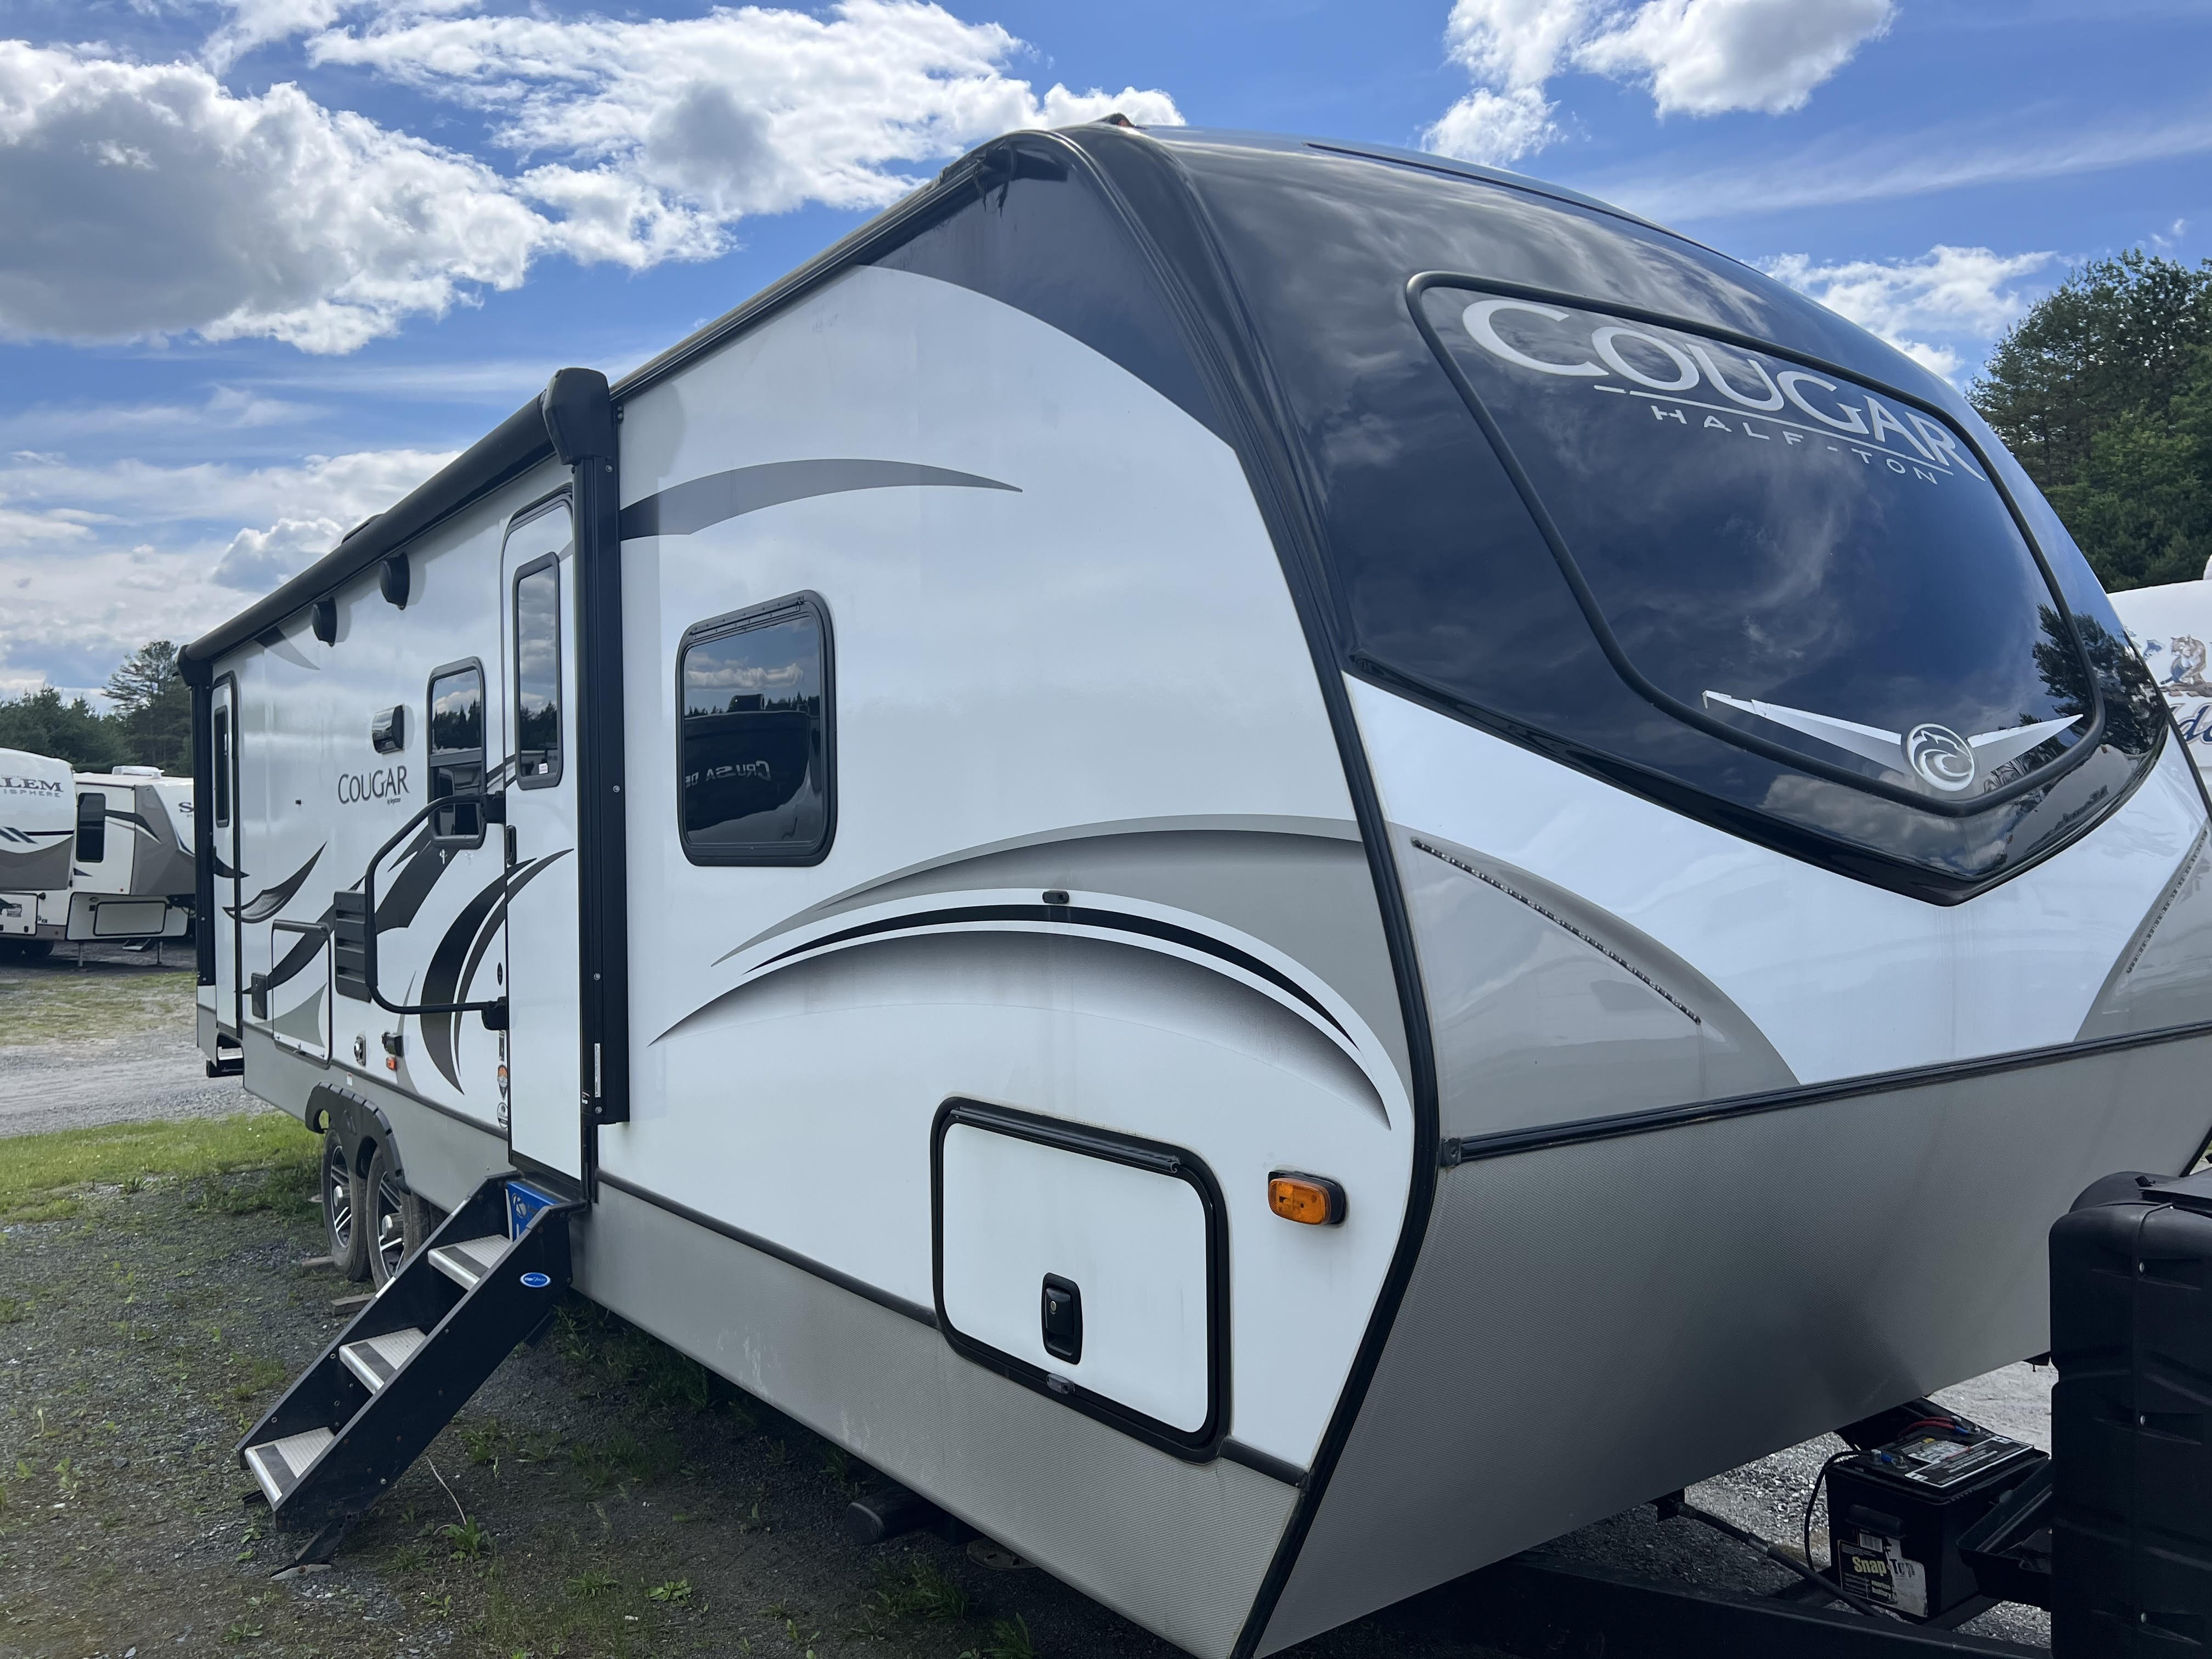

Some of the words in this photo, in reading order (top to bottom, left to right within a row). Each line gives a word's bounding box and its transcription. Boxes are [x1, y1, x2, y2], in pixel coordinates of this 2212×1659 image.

[1463, 299, 1985, 482] COUGAR
[1650, 405, 1938, 485] HALF-TON
[0, 777, 64, 792] LEM
[338, 765, 410, 804] COUGAR
[1852, 1556, 1887, 1577] Snap
